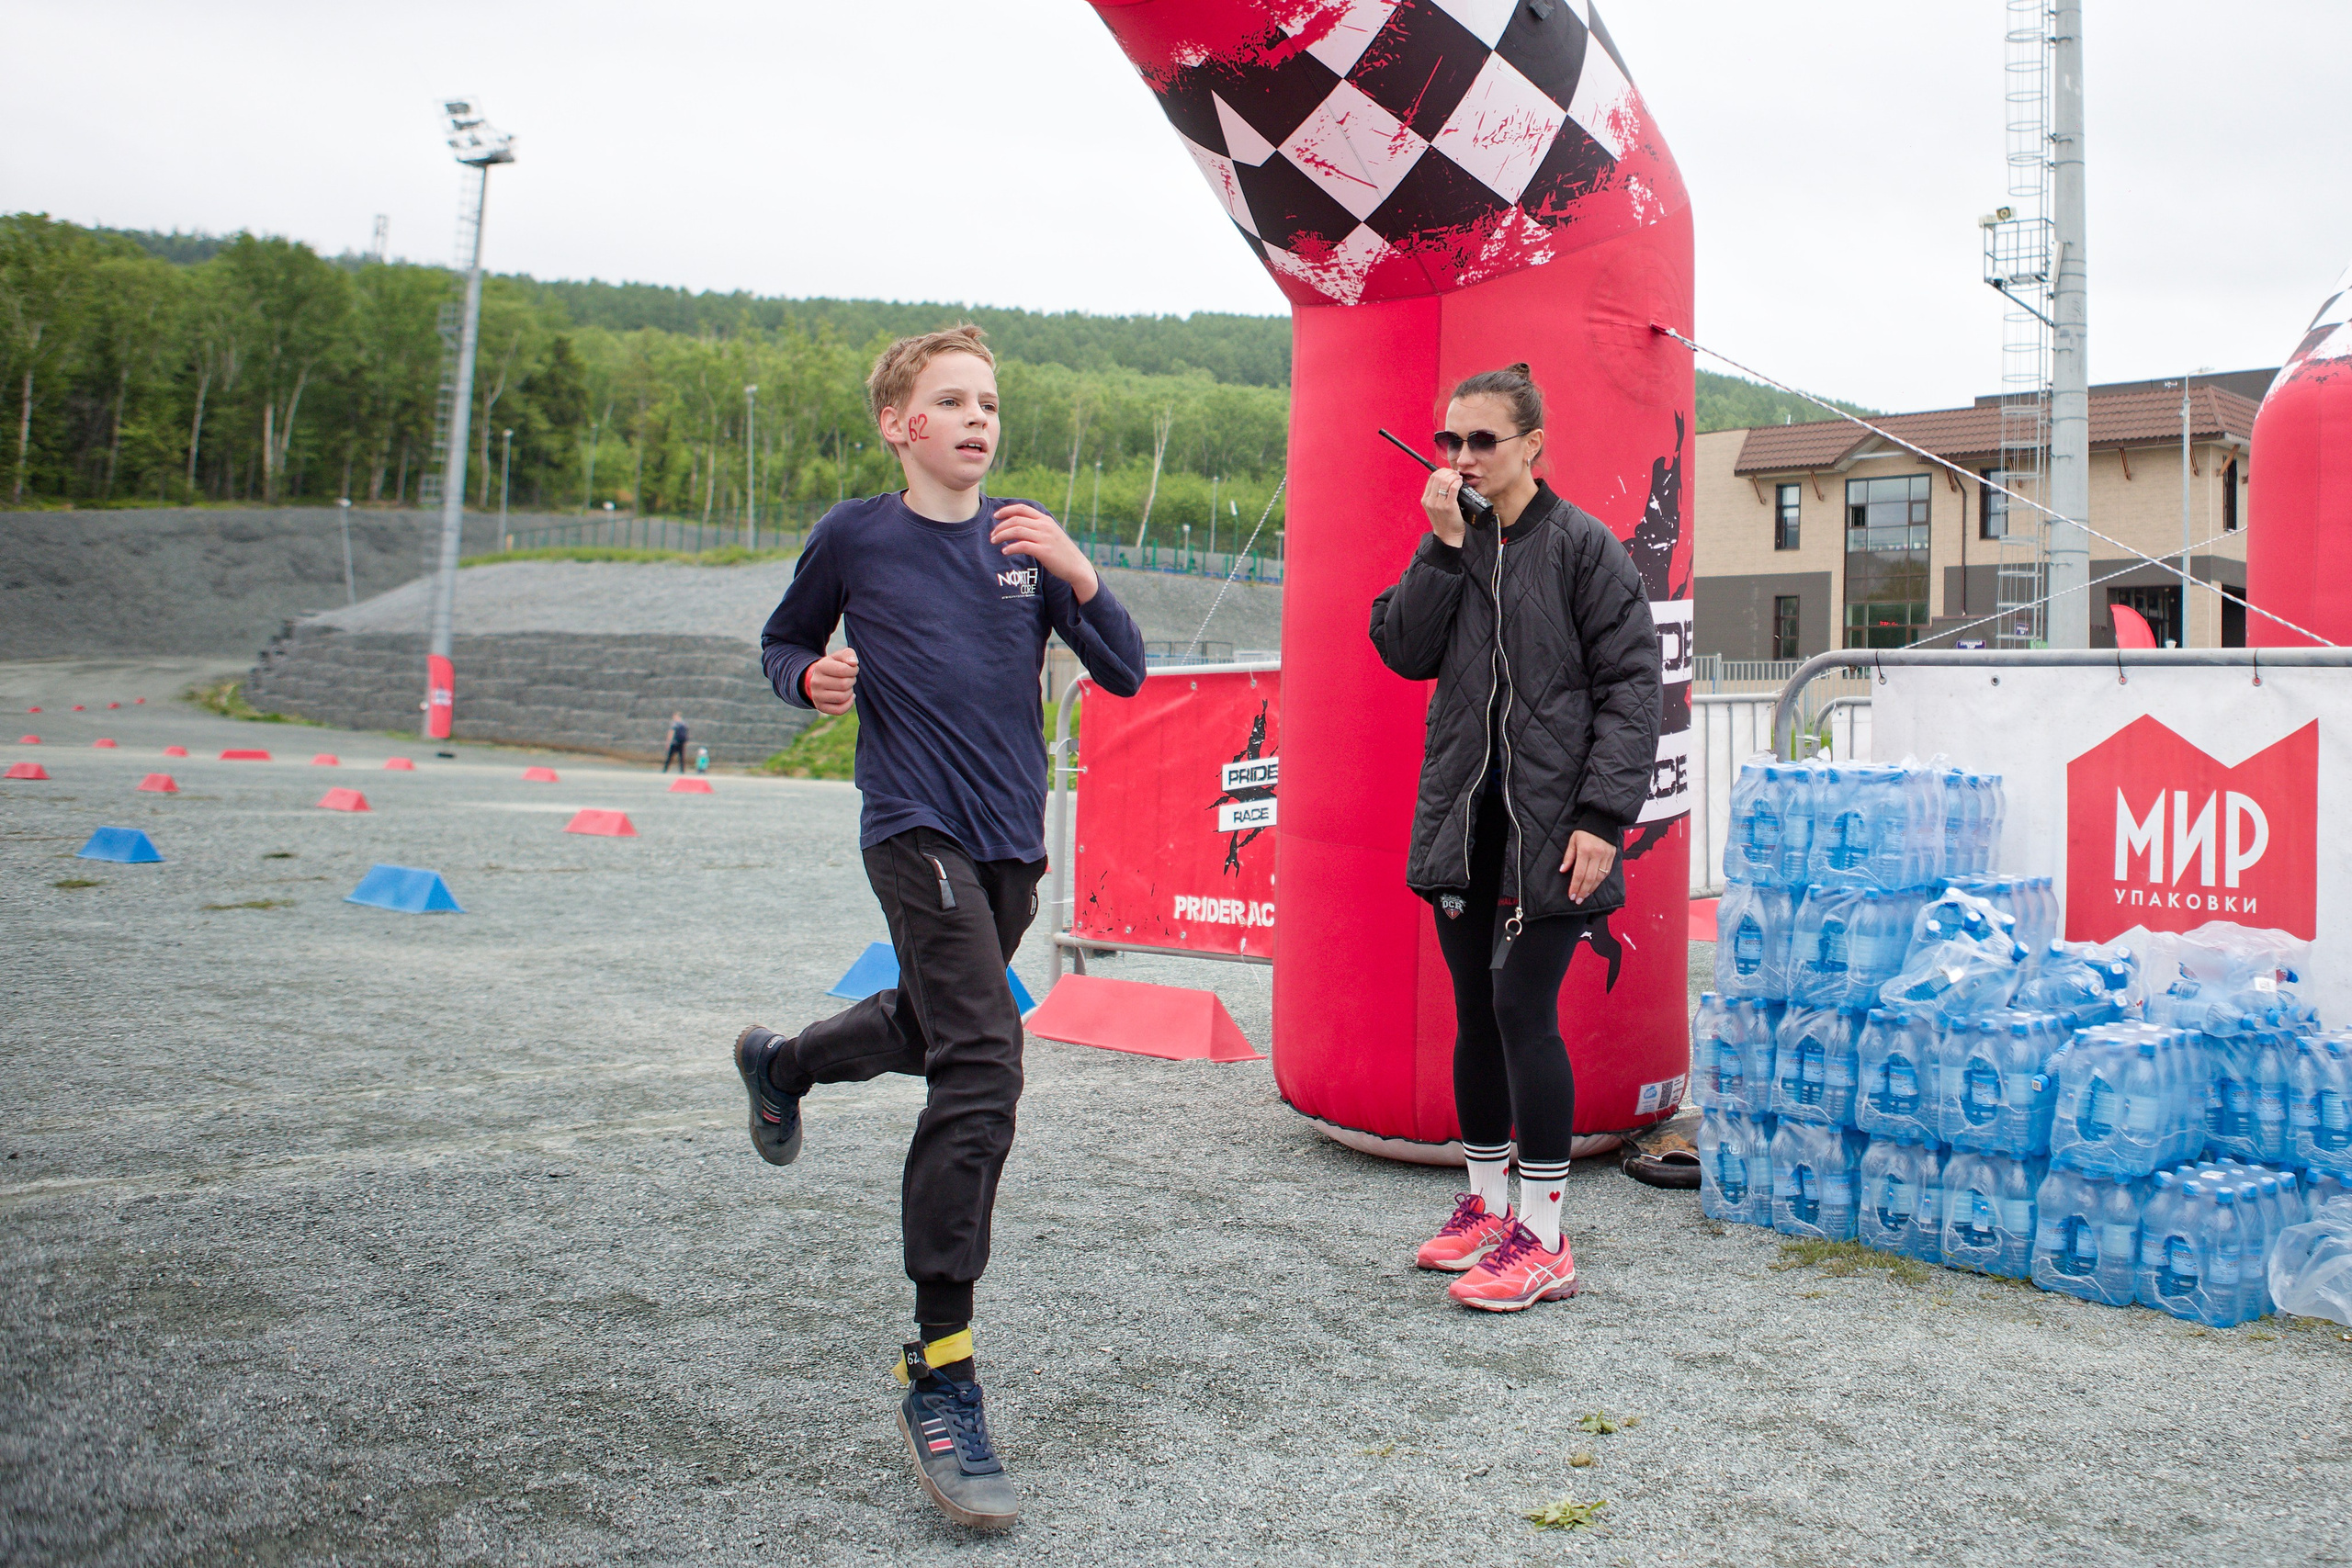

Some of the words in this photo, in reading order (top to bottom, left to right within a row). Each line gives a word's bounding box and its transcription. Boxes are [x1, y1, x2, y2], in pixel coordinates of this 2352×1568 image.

[908, 413, 930, 443] 62
[1020, 584, 1036, 594] CORE
[1227, 763, 1278, 785] PRIDE
[1233, 807, 1269, 823] RACE
[2114, 785, 2269, 888] МИР
[2114, 888, 2257, 914] УПАКОВКИ
[907, 1351, 920, 1365] 62
